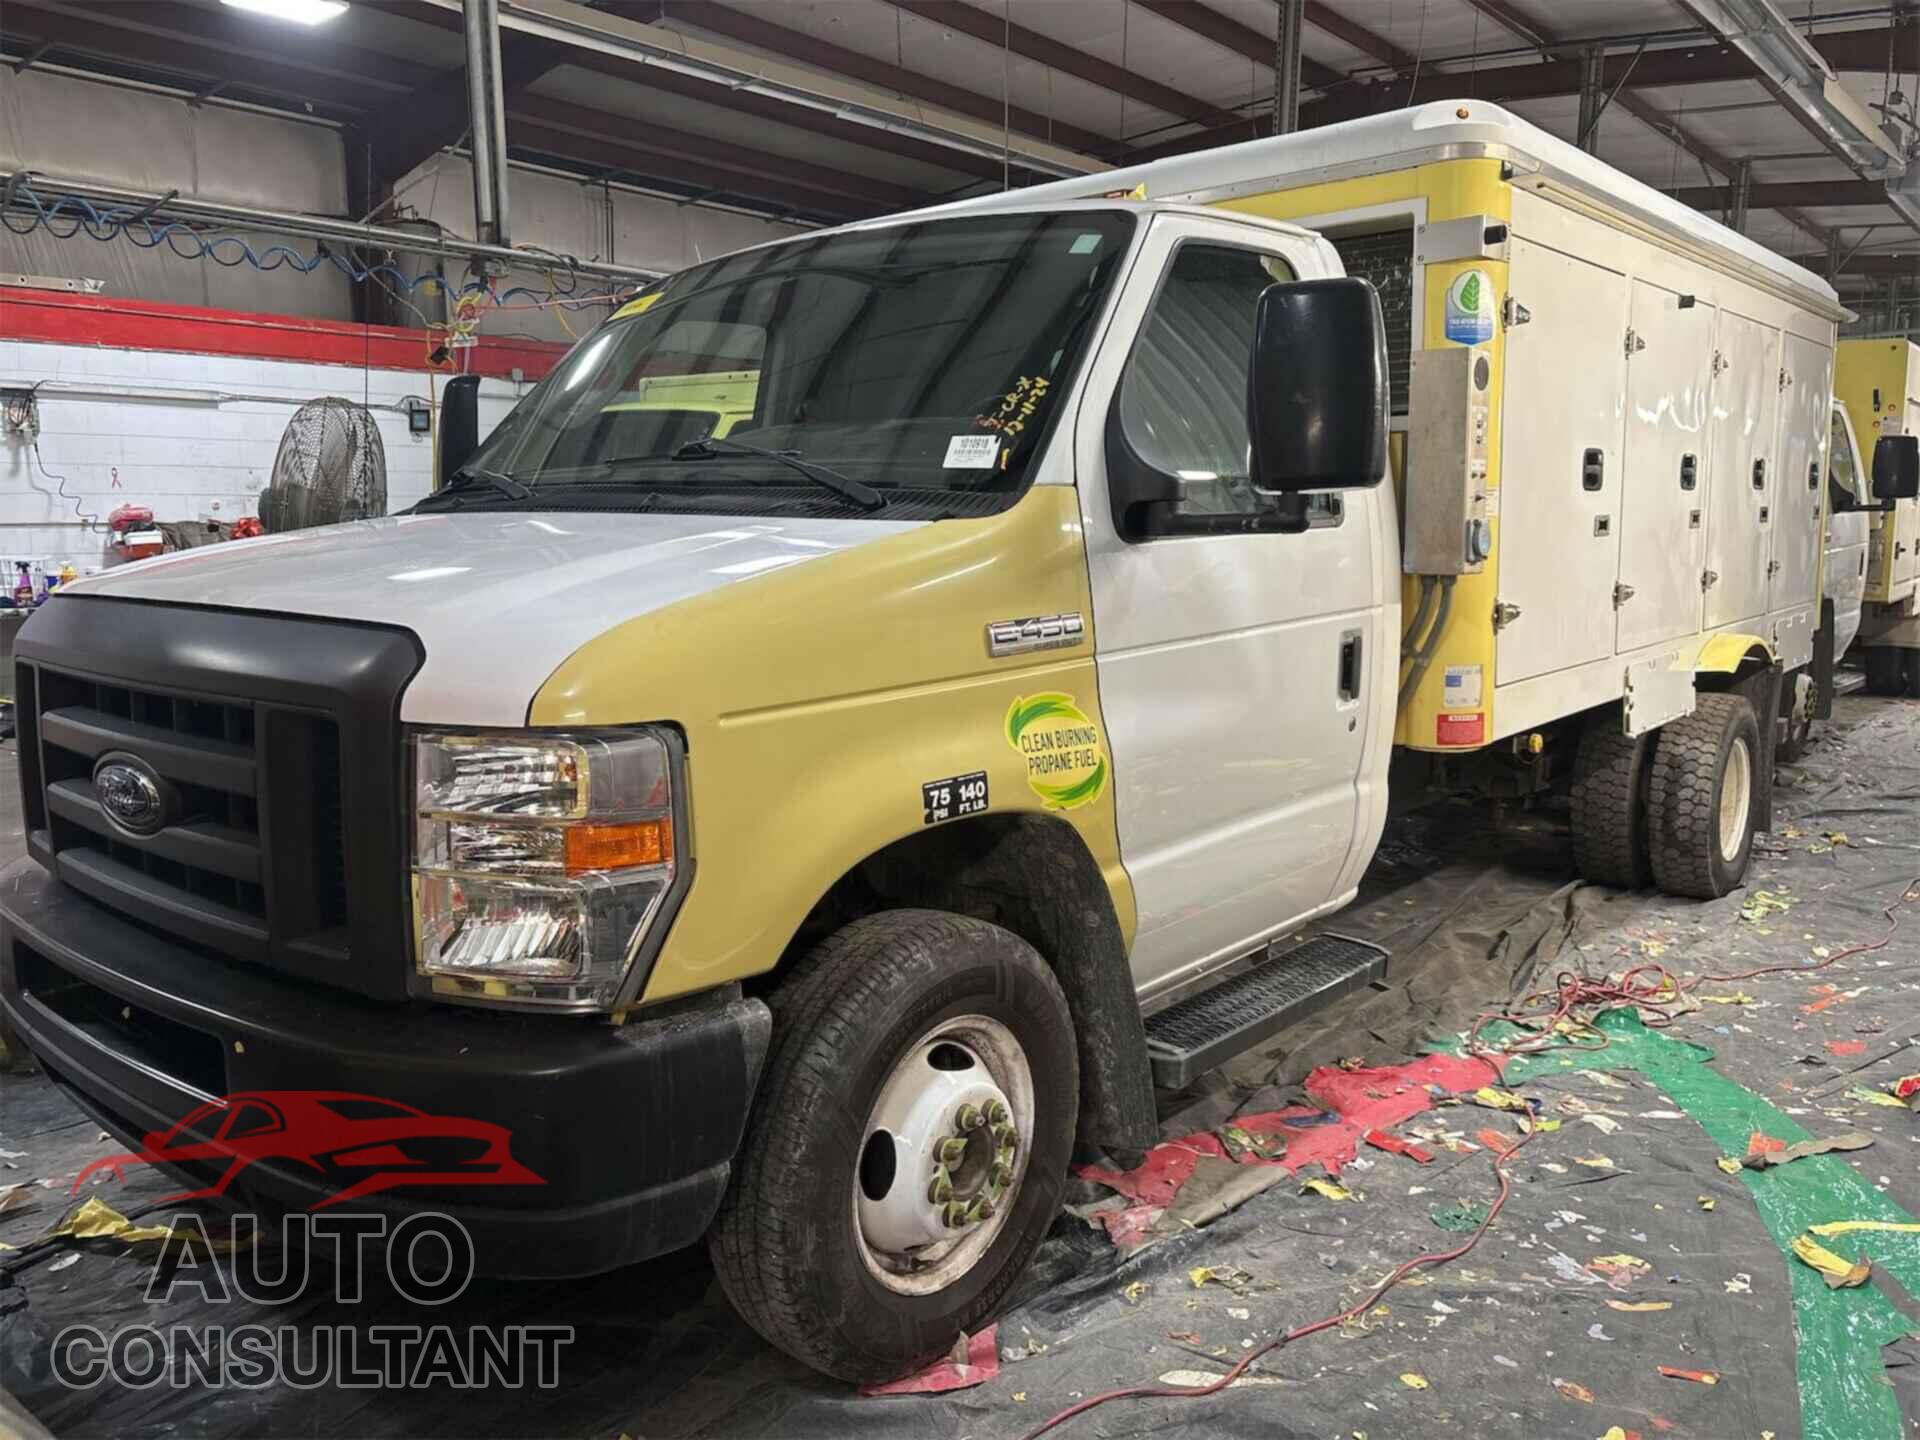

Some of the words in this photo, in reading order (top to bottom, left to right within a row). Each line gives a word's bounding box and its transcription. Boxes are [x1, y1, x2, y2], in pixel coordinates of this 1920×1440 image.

[1021, 731, 1054, 753] CLEAN
[1055, 726, 1097, 749] BURNING
[1028, 751, 1073, 776] PROPANE
[1074, 748, 1097, 769] FUEL
[929, 787, 951, 808] 75
[959, 780, 986, 801] 140
[933, 807, 949, 822] PSI
[959, 802, 972, 814] FT.
[973, 799, 987, 810] LB.
